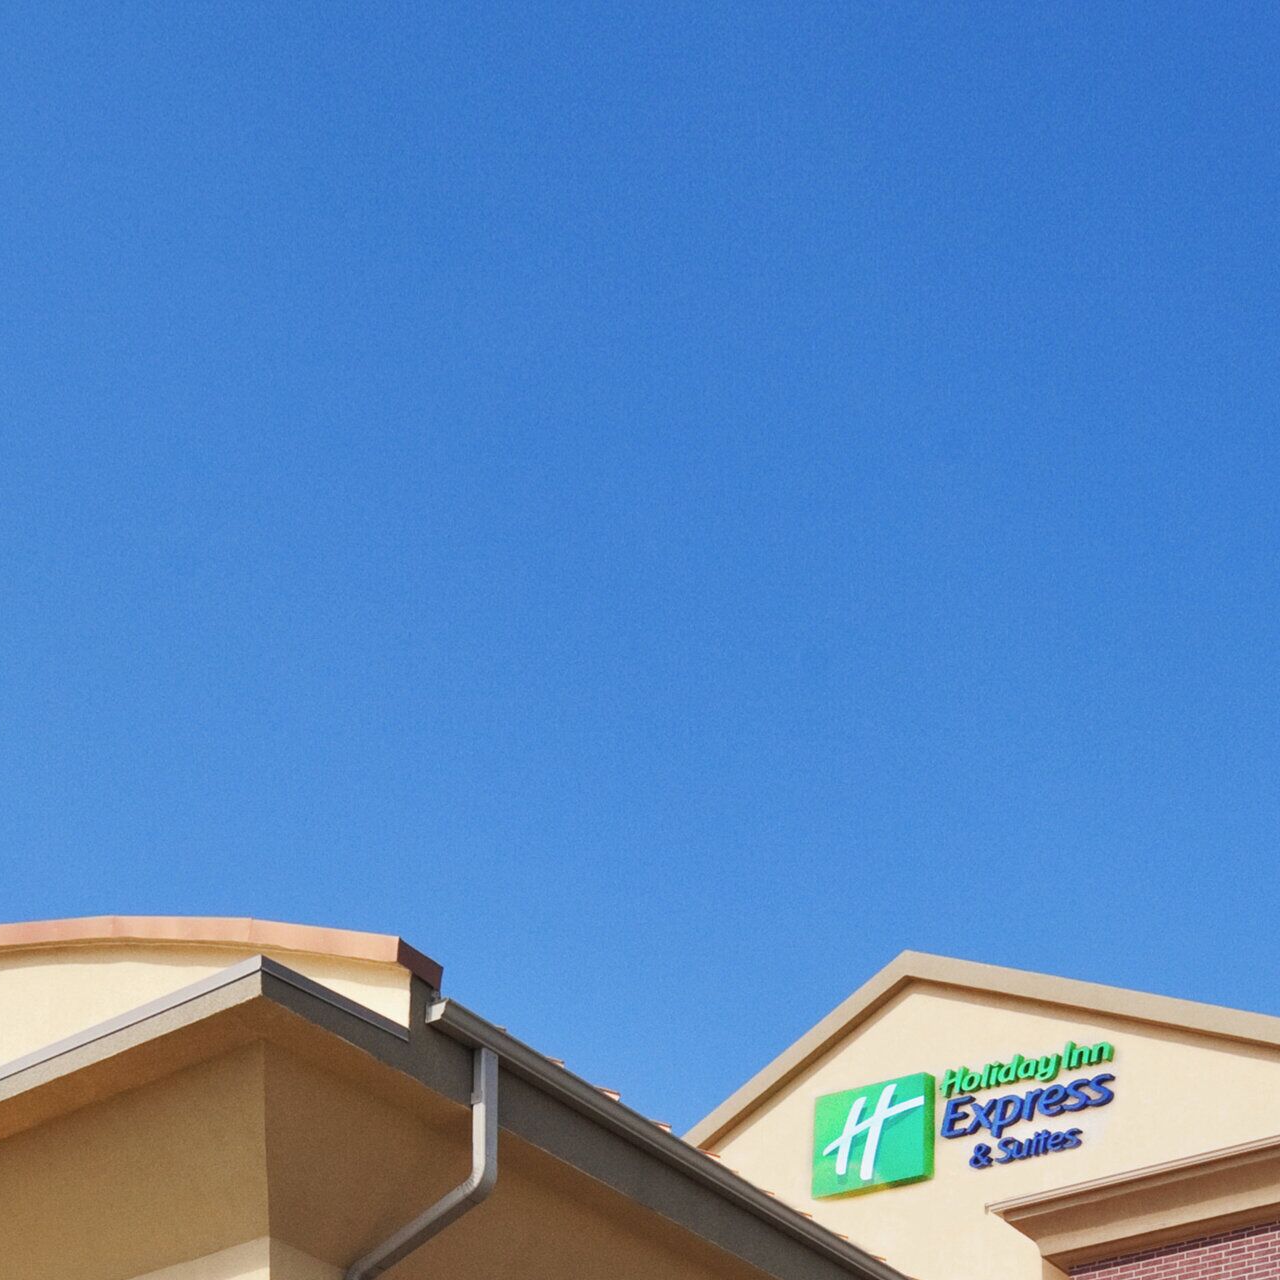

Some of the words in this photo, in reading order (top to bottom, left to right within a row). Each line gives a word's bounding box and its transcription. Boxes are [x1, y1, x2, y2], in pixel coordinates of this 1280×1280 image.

[941, 1053, 1061, 1098] Holiday
[1061, 1040, 1115, 1071] Inn
[940, 1073, 1116, 1139] Express
[969, 1143, 993, 1170] &
[995, 1128, 1083, 1163] Suites
